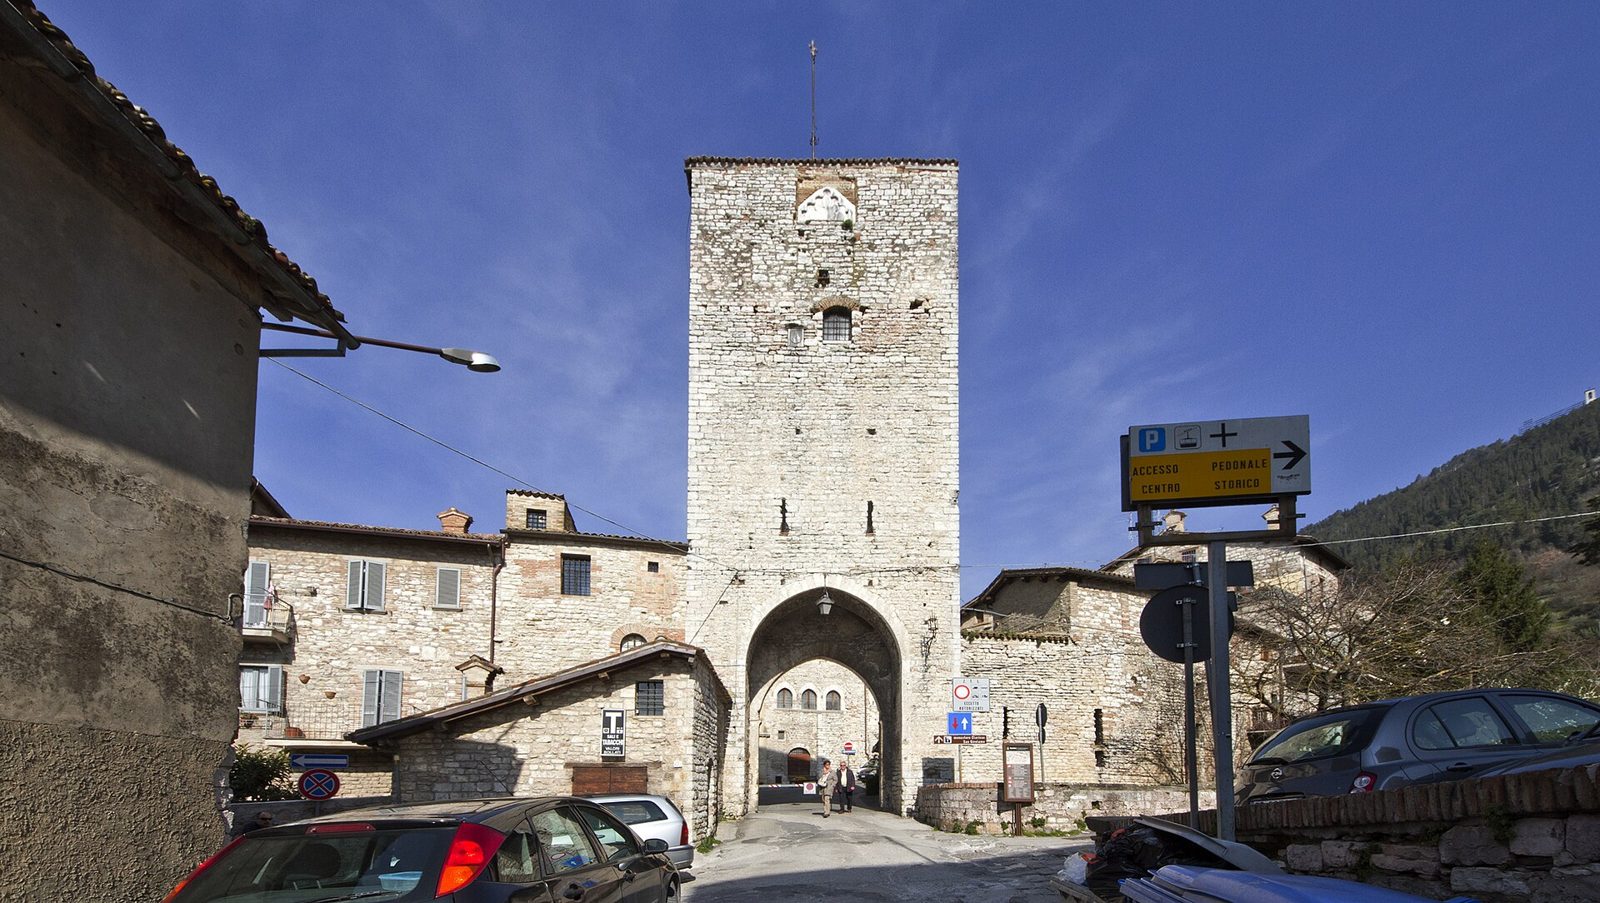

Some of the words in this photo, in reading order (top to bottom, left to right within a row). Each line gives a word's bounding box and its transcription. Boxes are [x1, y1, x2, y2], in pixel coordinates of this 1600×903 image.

[1132, 464, 1179, 476] ACCESSO
[1212, 458, 1267, 471] PEDONALE
[1142, 482, 1180, 494] CENTRO
[1214, 478, 1260, 490] STORICO
[605, 712, 622, 733] T
